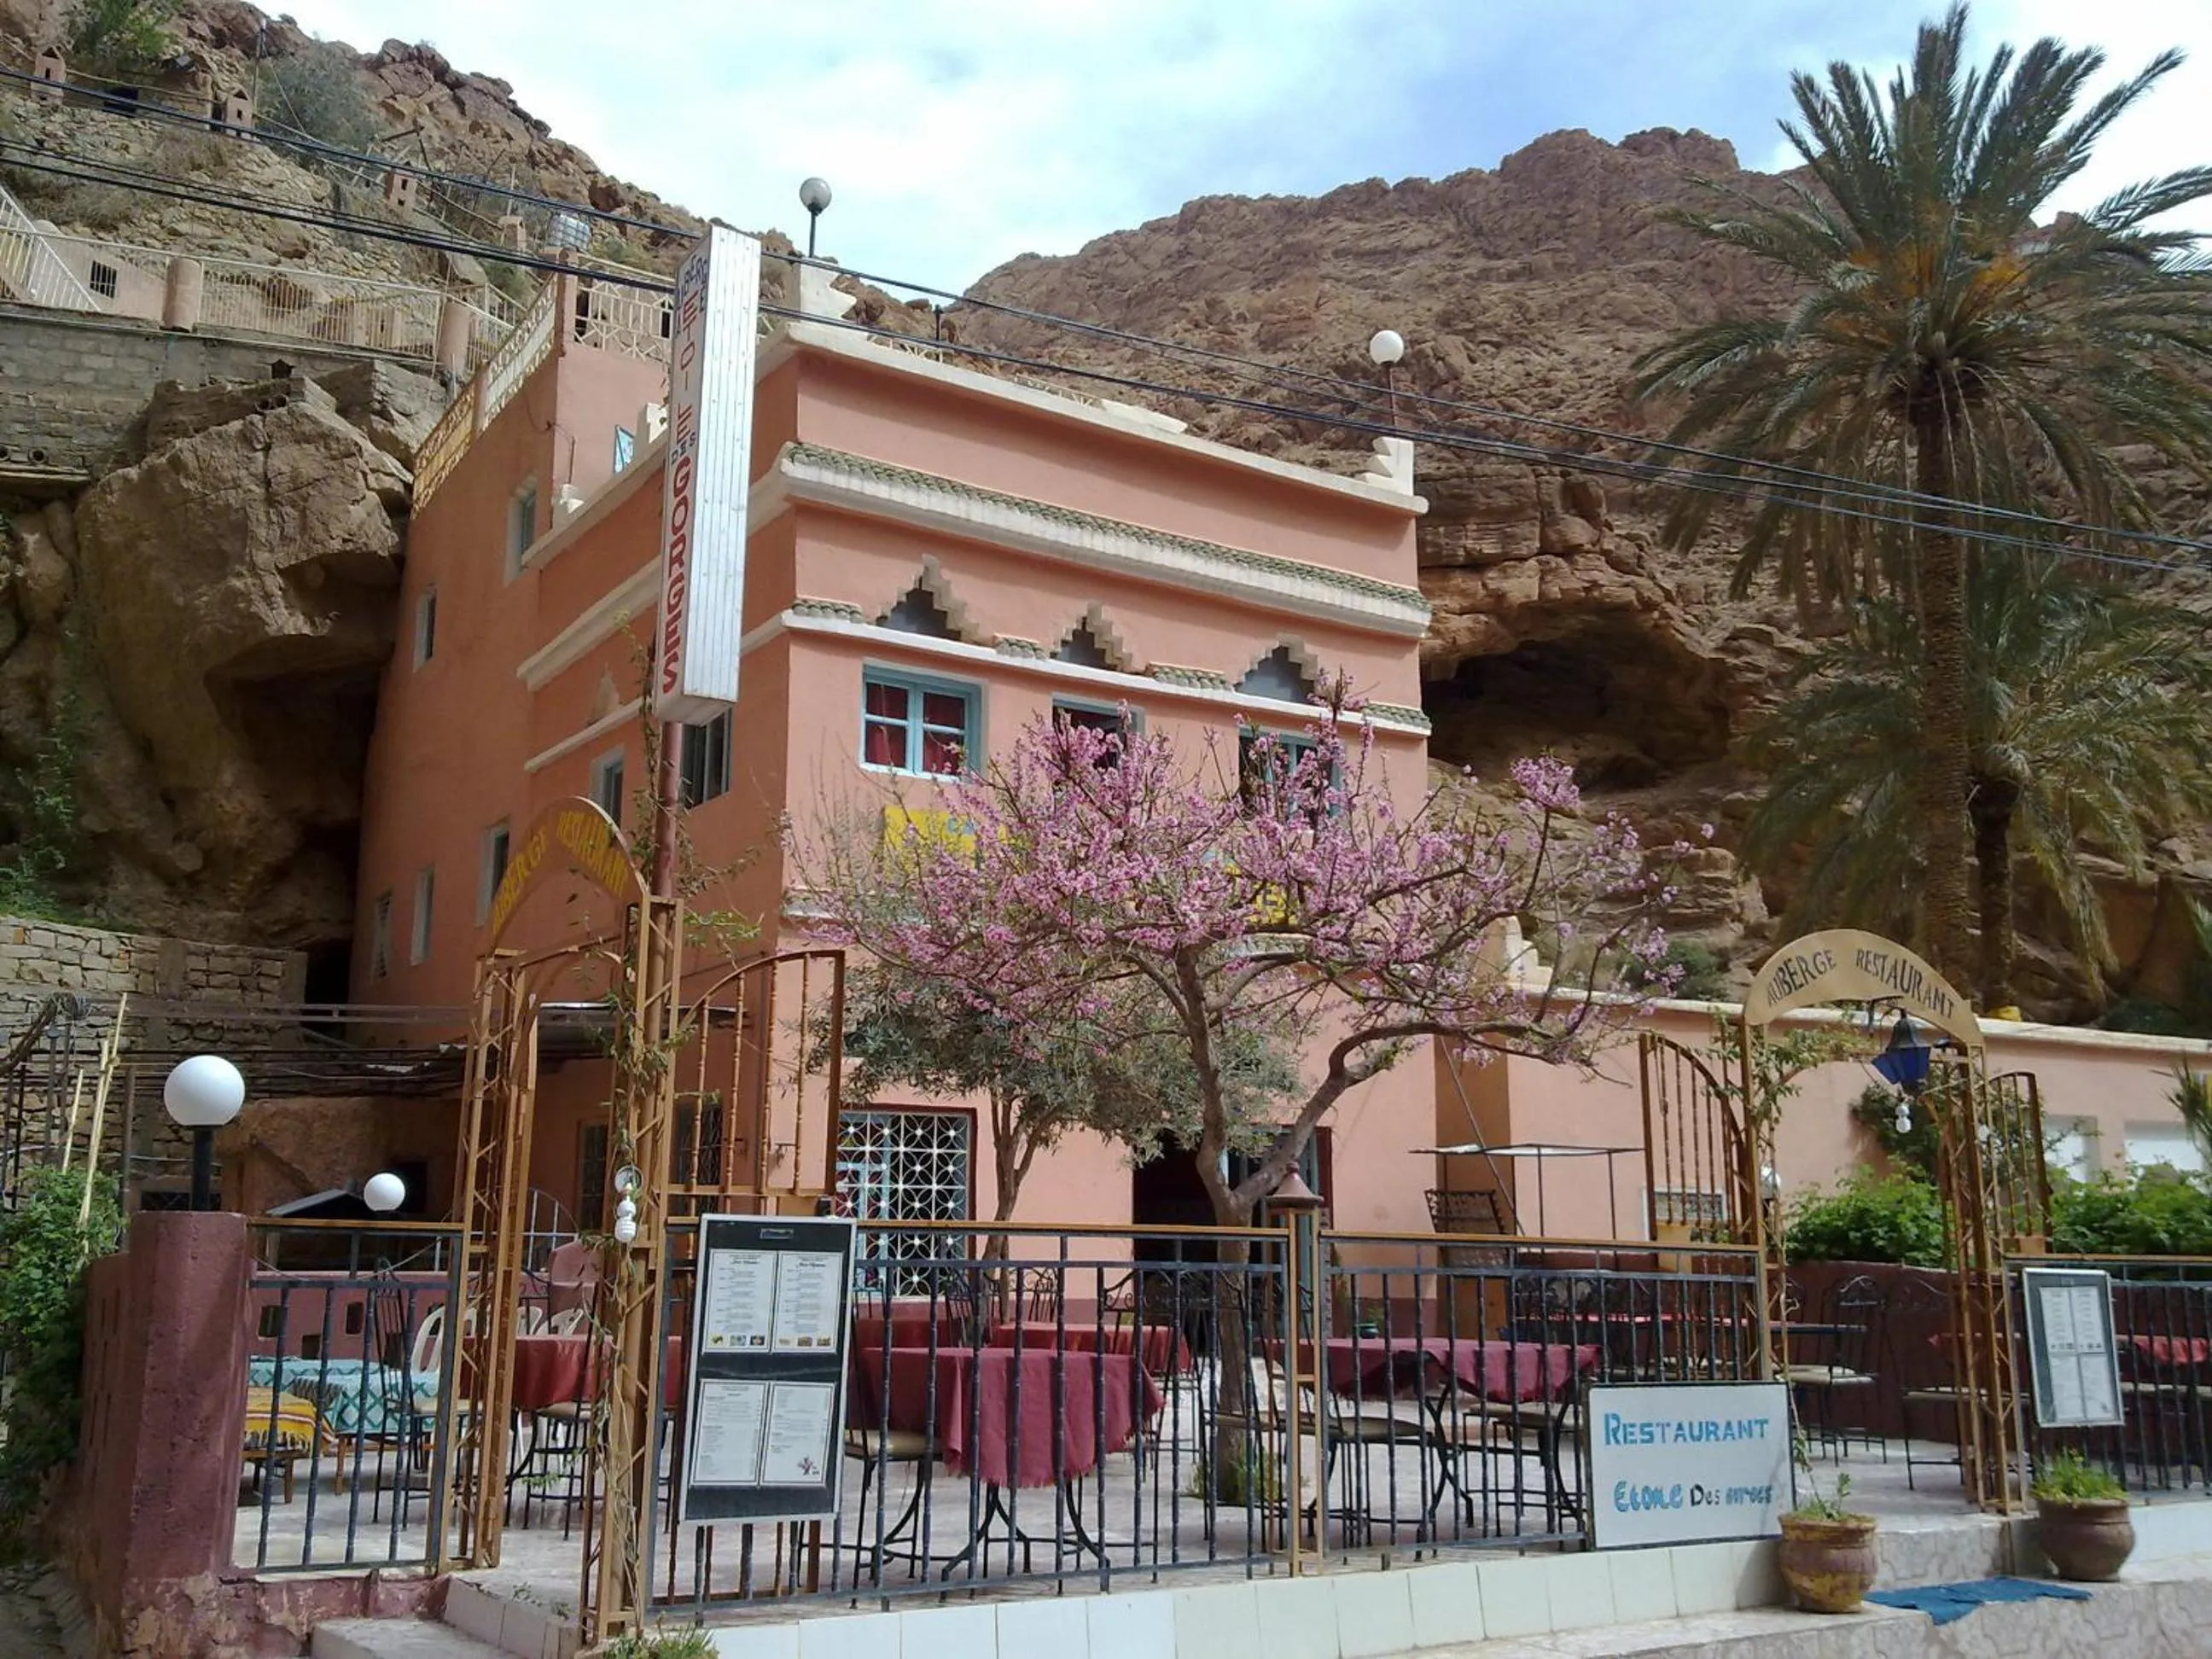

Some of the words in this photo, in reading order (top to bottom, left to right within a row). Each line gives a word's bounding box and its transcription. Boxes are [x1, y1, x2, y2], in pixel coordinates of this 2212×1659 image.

[671, 432, 696, 466] DES
[663, 455, 691, 693] GORGES
[1767, 949, 1837, 1008] AUBERGE
[1855, 948, 1955, 1020] RESTAURANT
